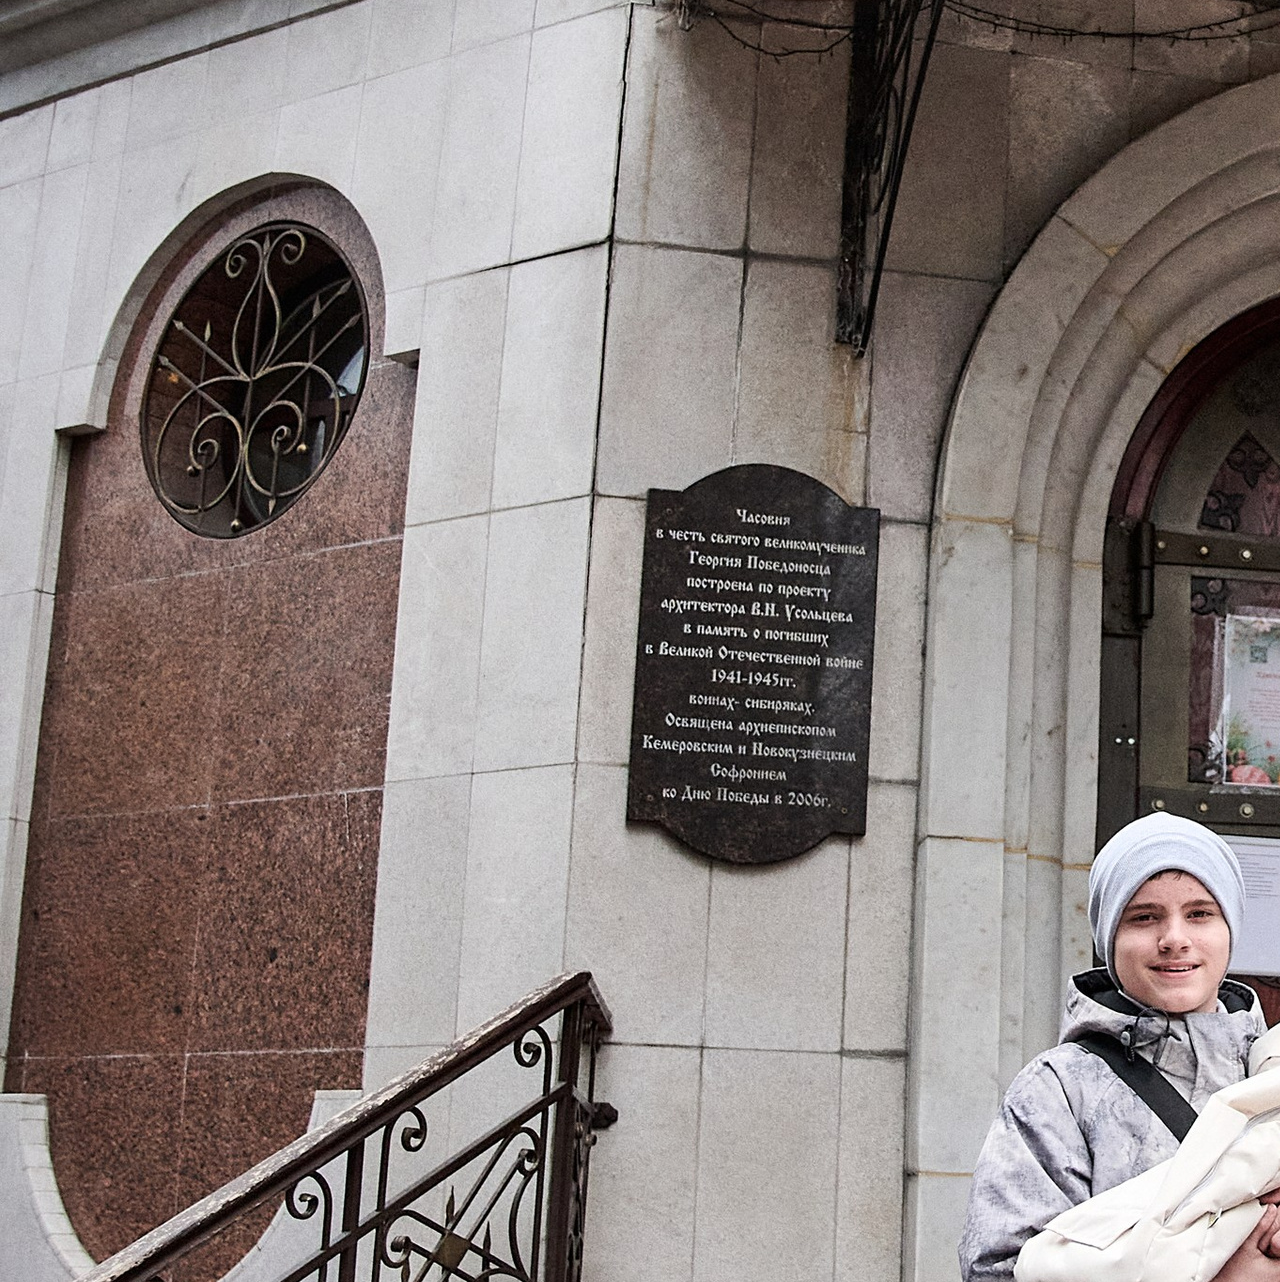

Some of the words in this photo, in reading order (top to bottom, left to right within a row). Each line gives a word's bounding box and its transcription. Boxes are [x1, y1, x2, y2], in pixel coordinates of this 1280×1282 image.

[736, 508, 791, 525] Часовня
[656, 528, 664, 538] в
[669, 529, 705, 541] честь
[711, 533, 760, 547] святого
[765, 537, 866, 555] великомученика
[689, 551, 741, 569] Георгия
[748, 555, 831, 576] Победоносца
[687, 577, 753, 592] построена
[759, 582, 773, 594] по
[778, 585, 831, 601] проекту
[661, 598, 745, 616] архитектора
[786, 605, 853, 624] Усольцева
[684, 623, 691, 633] в
[697, 624, 747, 638] память
[753, 630, 759, 639] о
[765, 630, 829, 647] погибших
[645, 644, 653, 654] в
[659, 642, 713, 659] Великой
[718, 646, 820, 667] Отечественной
[826, 657, 863, 670] войне
[711, 669, 796, 688] 1941-1945гг.
[745, 699, 815, 715] сибиряках.
[665, 712, 733, 731] Освящена
[739, 722, 836, 737] архиепископом
[642, 735, 733, 755] Кемеровским
[739, 746, 746, 755] и
[752, 742, 857, 762] Новокузнецким
[711, 763, 787, 782] Софронием
[662, 788, 676, 798] ко
[682, 786, 711, 802] Дню
[717, 788, 769, 805] Победы
[775, 795, 782, 804] в
[788, 792, 831, 807] 2006г.
